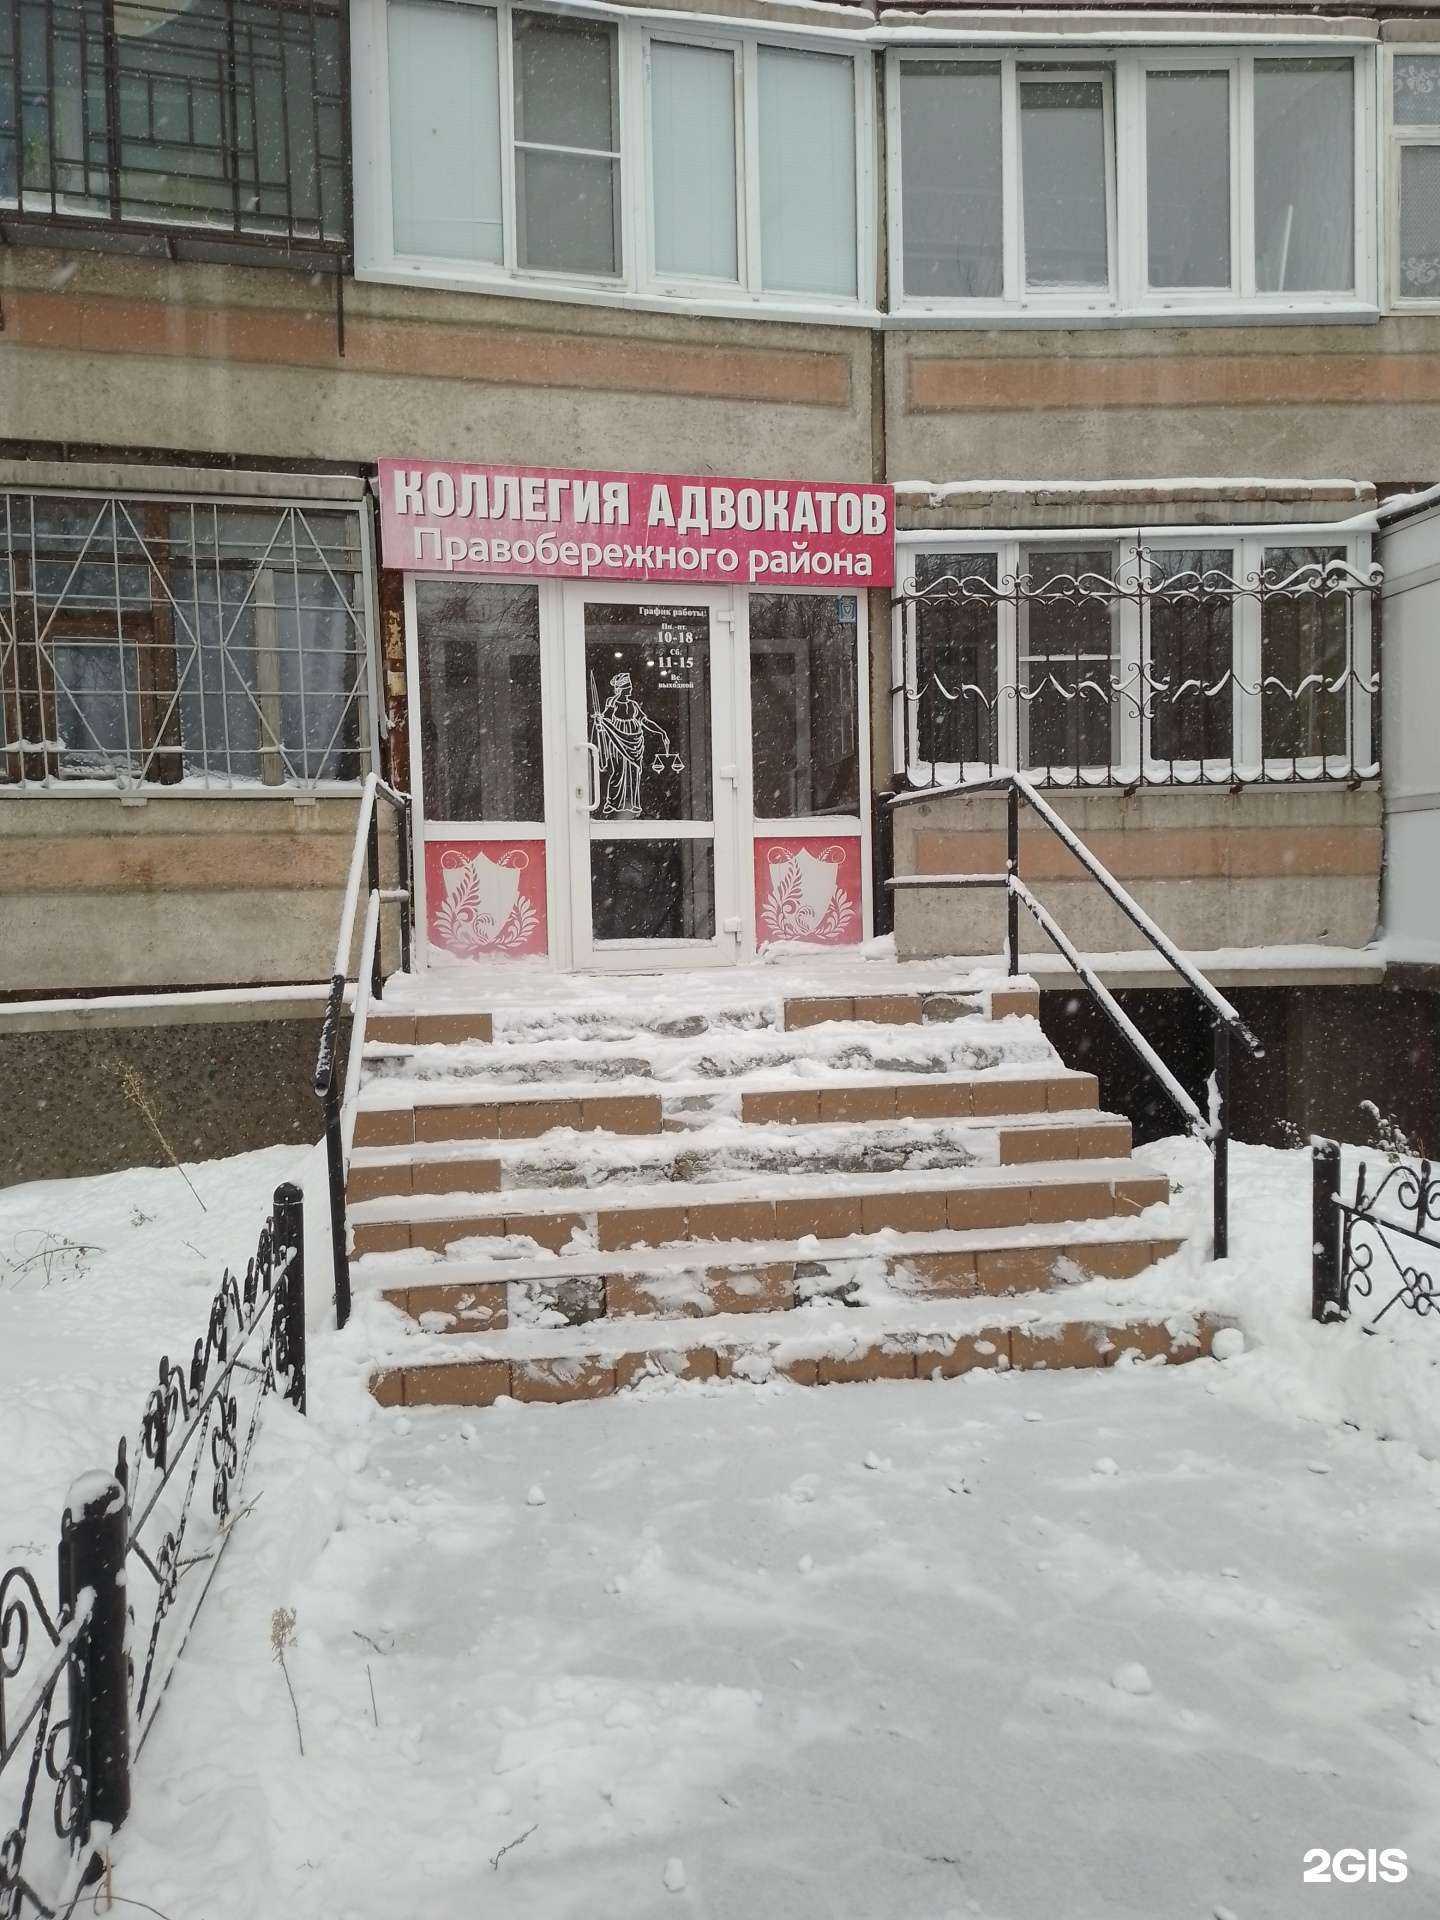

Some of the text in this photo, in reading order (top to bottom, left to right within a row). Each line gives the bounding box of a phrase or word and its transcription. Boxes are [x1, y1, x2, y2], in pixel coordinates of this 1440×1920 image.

[393, 470, 888, 536] КОЛЛЕГИЯ АДВОКАТОВ
[413, 526, 873, 582] Правобережного района
[638, 606, 672, 617] График
[657, 631, 694, 643] 10-18
[658, 656, 694, 668] 11-15
[658, 681, 694, 689] выходной
